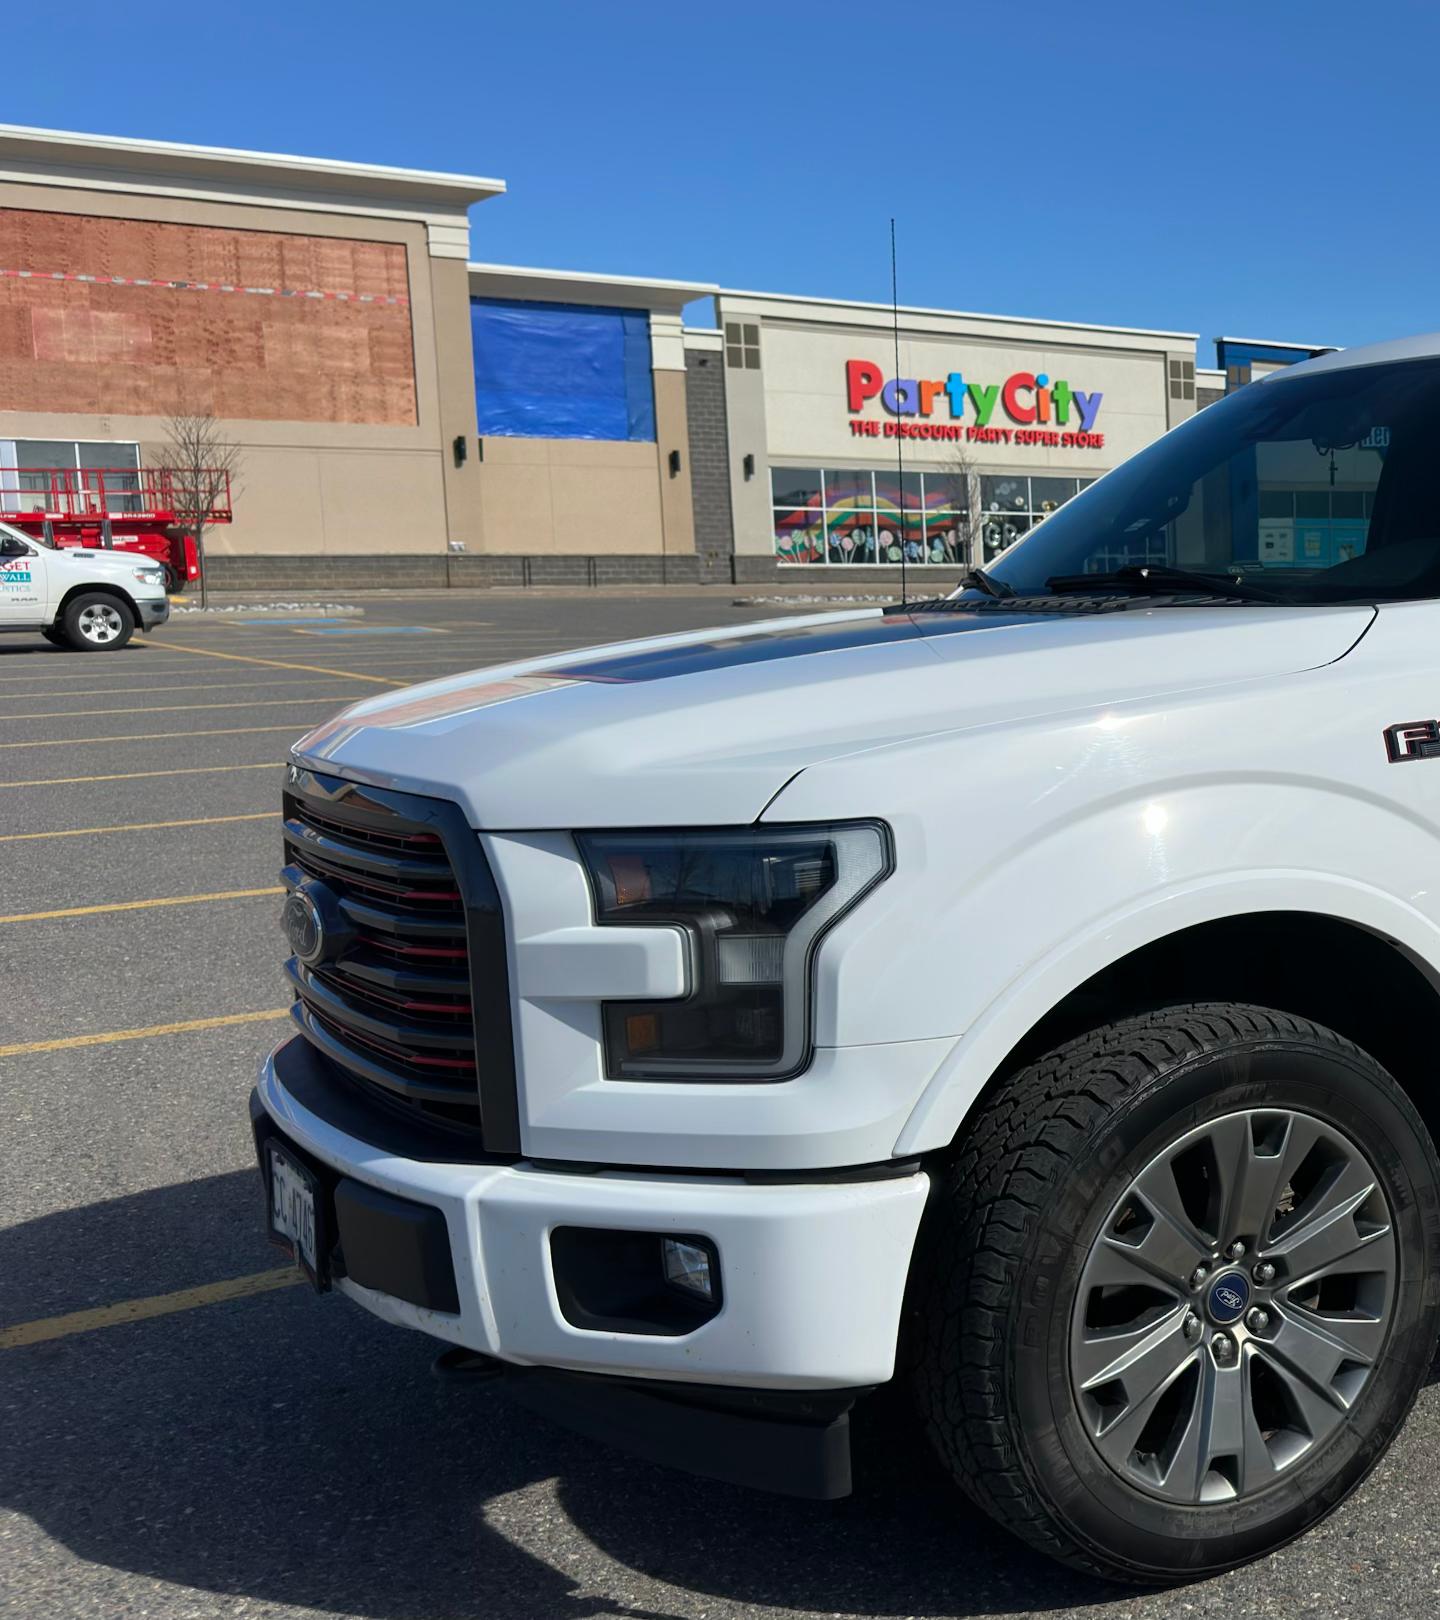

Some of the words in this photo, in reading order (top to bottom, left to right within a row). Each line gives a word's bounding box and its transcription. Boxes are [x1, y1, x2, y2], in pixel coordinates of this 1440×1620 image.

[850, 420, 880, 436] THE
[966, 427, 1013, 443] PARTY
[1015, 429, 1059, 447] SUPER
[1062, 432, 1105, 449] STORE
[0, 561, 31, 571] GET
[1219, 1289, 1241, 1307] Ford
